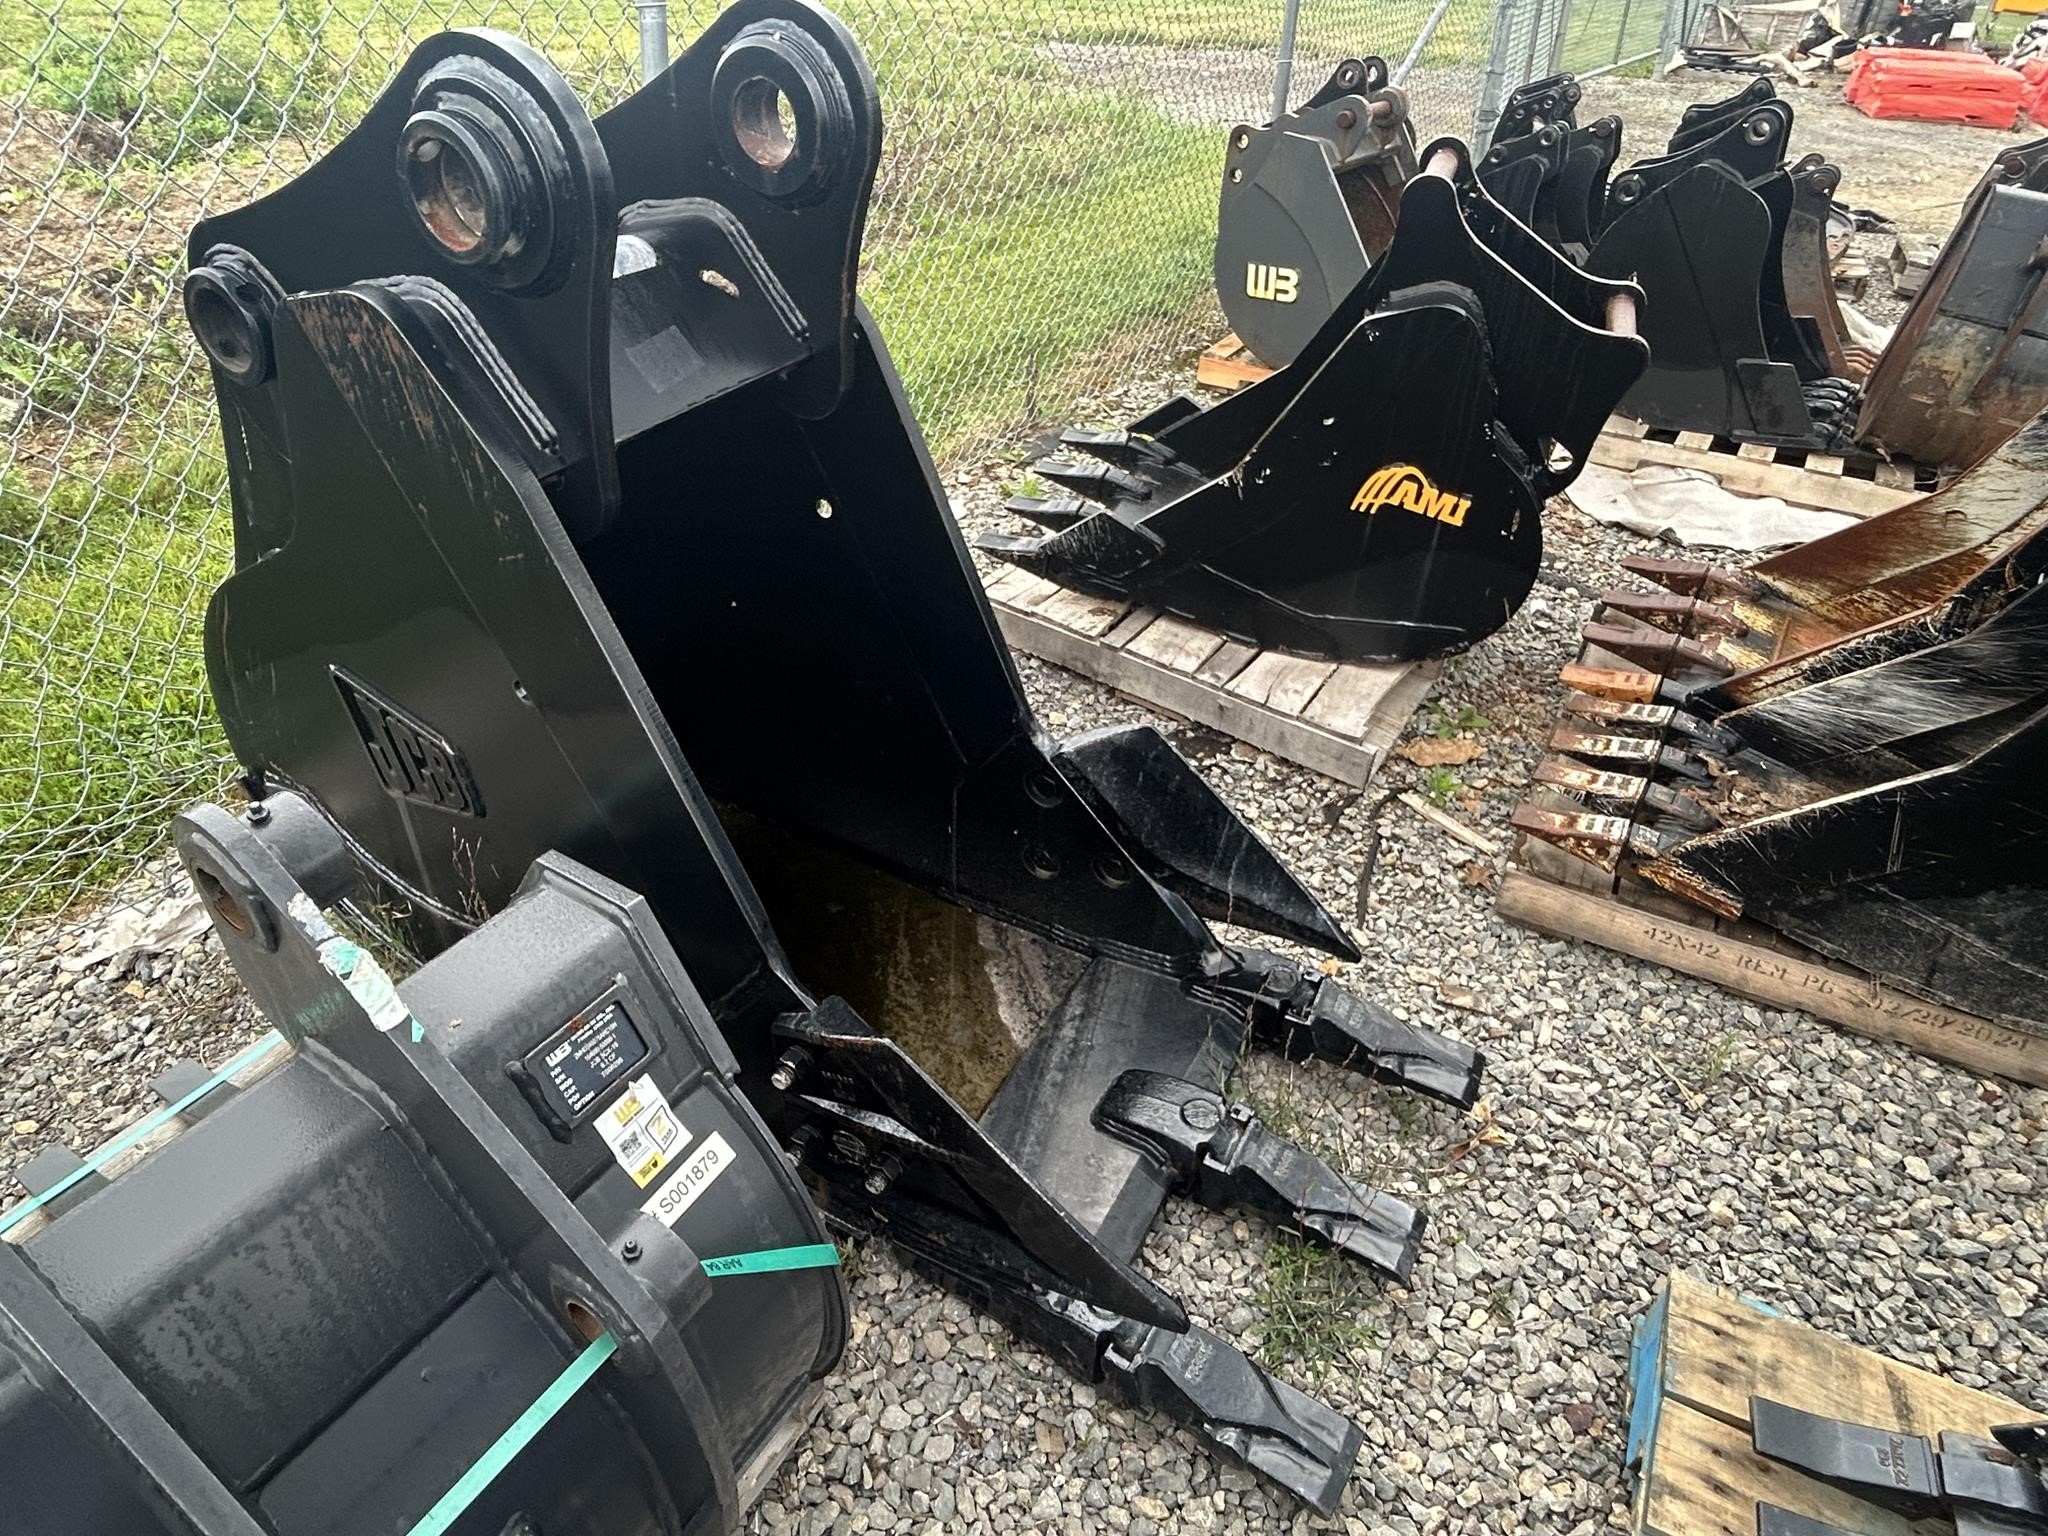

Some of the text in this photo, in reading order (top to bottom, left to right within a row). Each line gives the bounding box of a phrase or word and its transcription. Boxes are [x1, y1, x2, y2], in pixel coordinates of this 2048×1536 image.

[351, 692, 467, 811] JCB
[573, 1090, 596, 1111] OPTION
[659, 1149, 719, 1214] S001879
